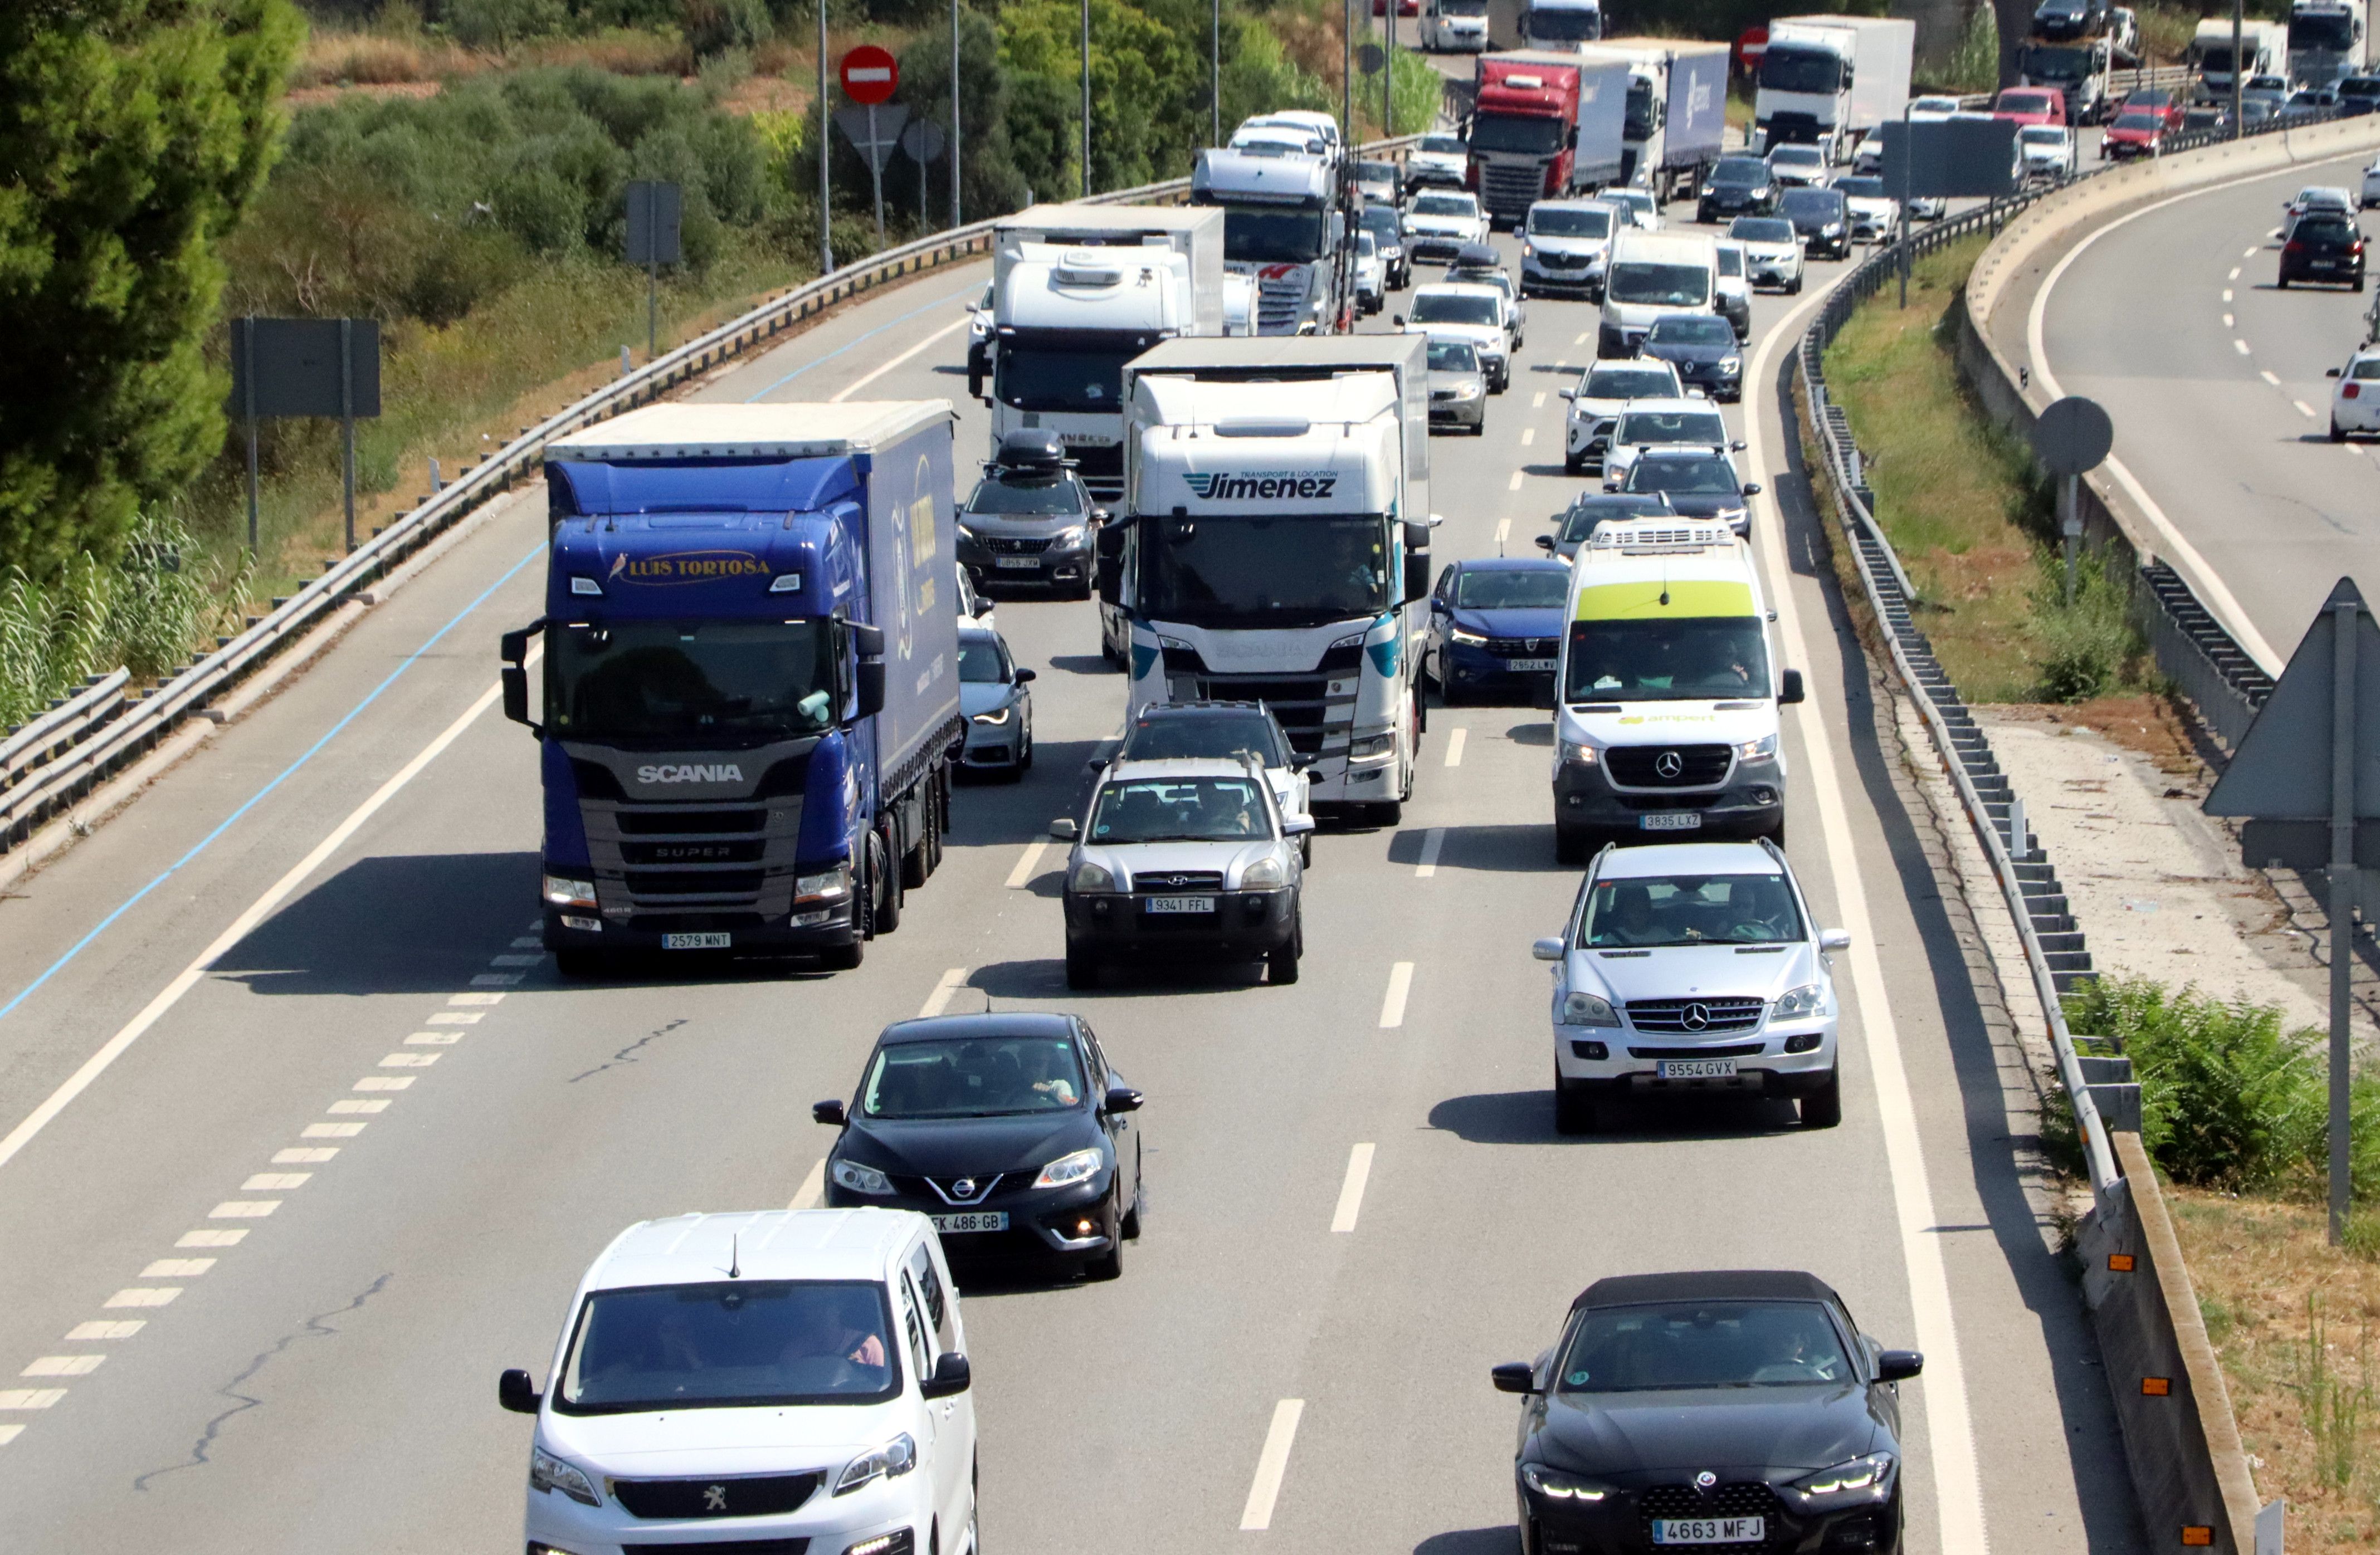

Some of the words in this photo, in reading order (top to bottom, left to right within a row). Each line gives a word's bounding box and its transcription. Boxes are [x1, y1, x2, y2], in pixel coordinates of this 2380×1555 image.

[1197, 473, 1337, 499] Jimenez
[630, 560, 672, 576] LUIS
[676, 559, 770, 575] TORTOSA
[637, 764, 744, 784] SCANIA
[1647, 816, 1675, 826] 3835
[1678, 815, 1699, 825] LXZ
[656, 847, 730, 857] SUPER
[1156, 899, 1182, 911] 9341
[1188, 899, 1209, 911] FFL
[671, 935, 701, 947] 2579
[705, 934, 728, 946] MNT
[1669, 1064, 1703, 1076] 9554
[1706, 1062, 1732, 1075] GVX
[1667, 1522, 1716, 1539] 4663
[1723, 1519, 1760, 1538] MFJ
